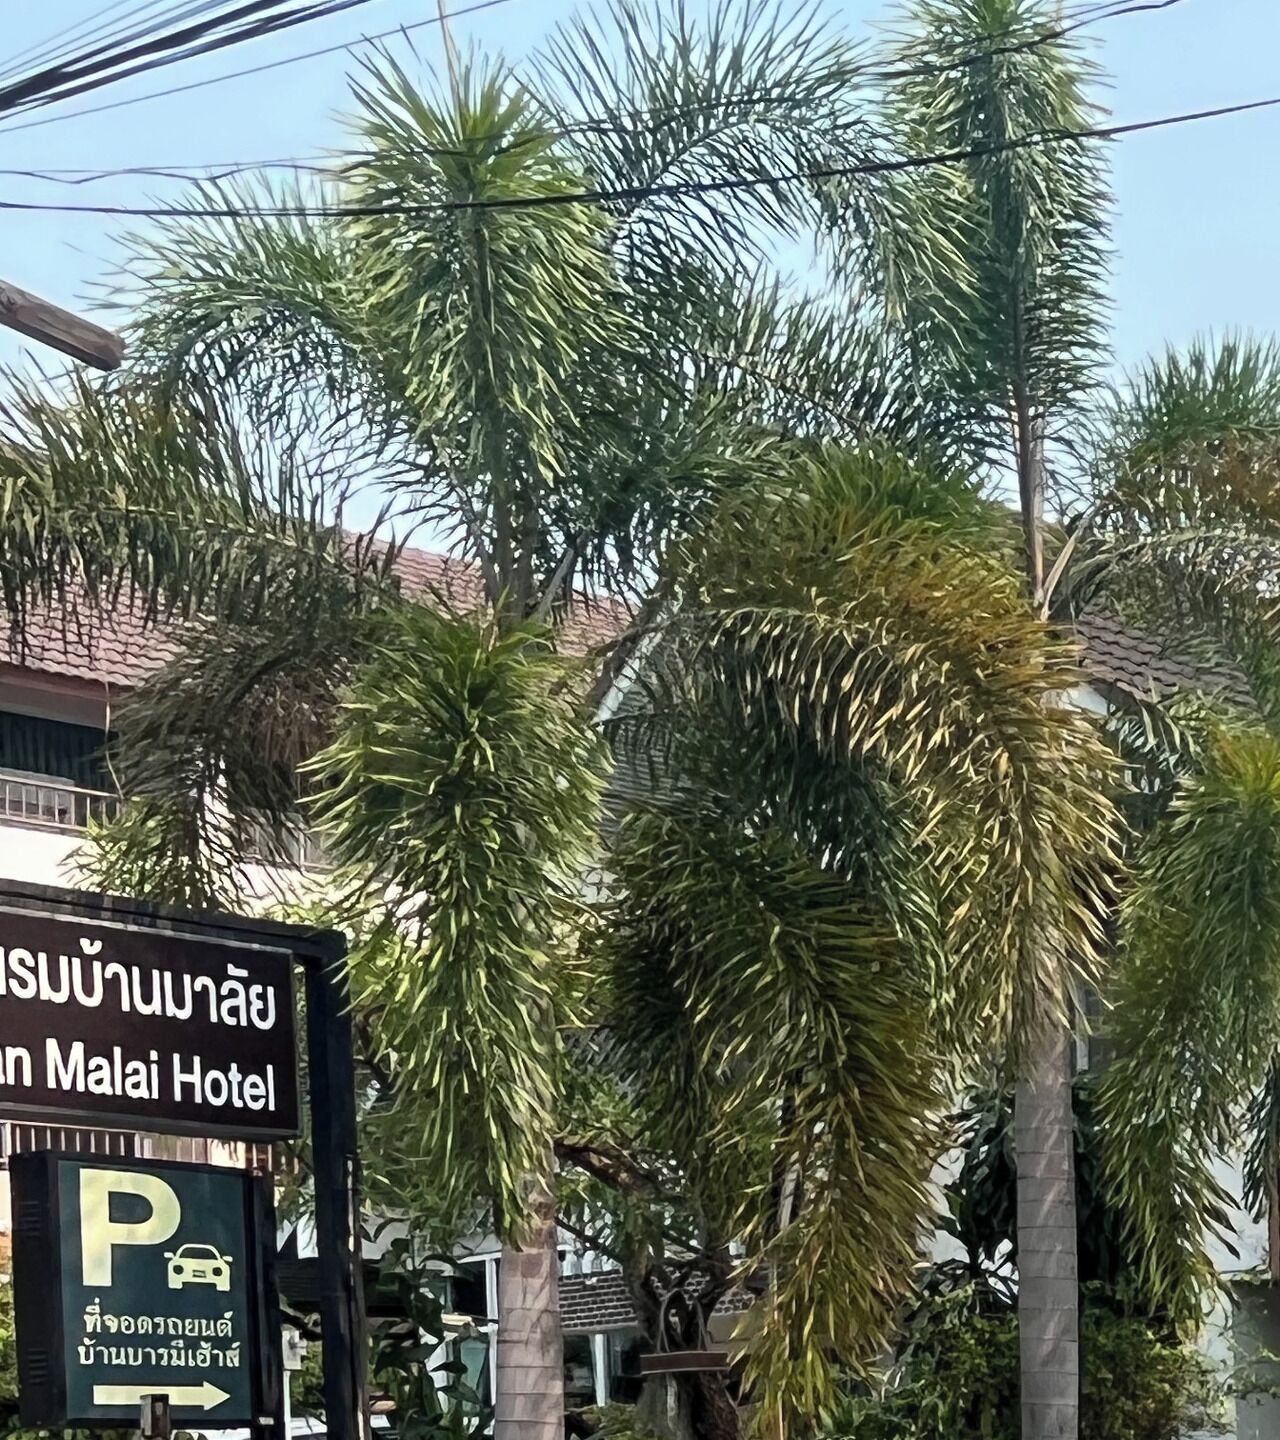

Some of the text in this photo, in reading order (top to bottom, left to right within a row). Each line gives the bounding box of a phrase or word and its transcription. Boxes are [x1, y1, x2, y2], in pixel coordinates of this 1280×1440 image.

[46, 1038, 159, 1101] Malai
[172, 1053, 275, 1112] Hotel
[80, 1168, 181, 1287] P
